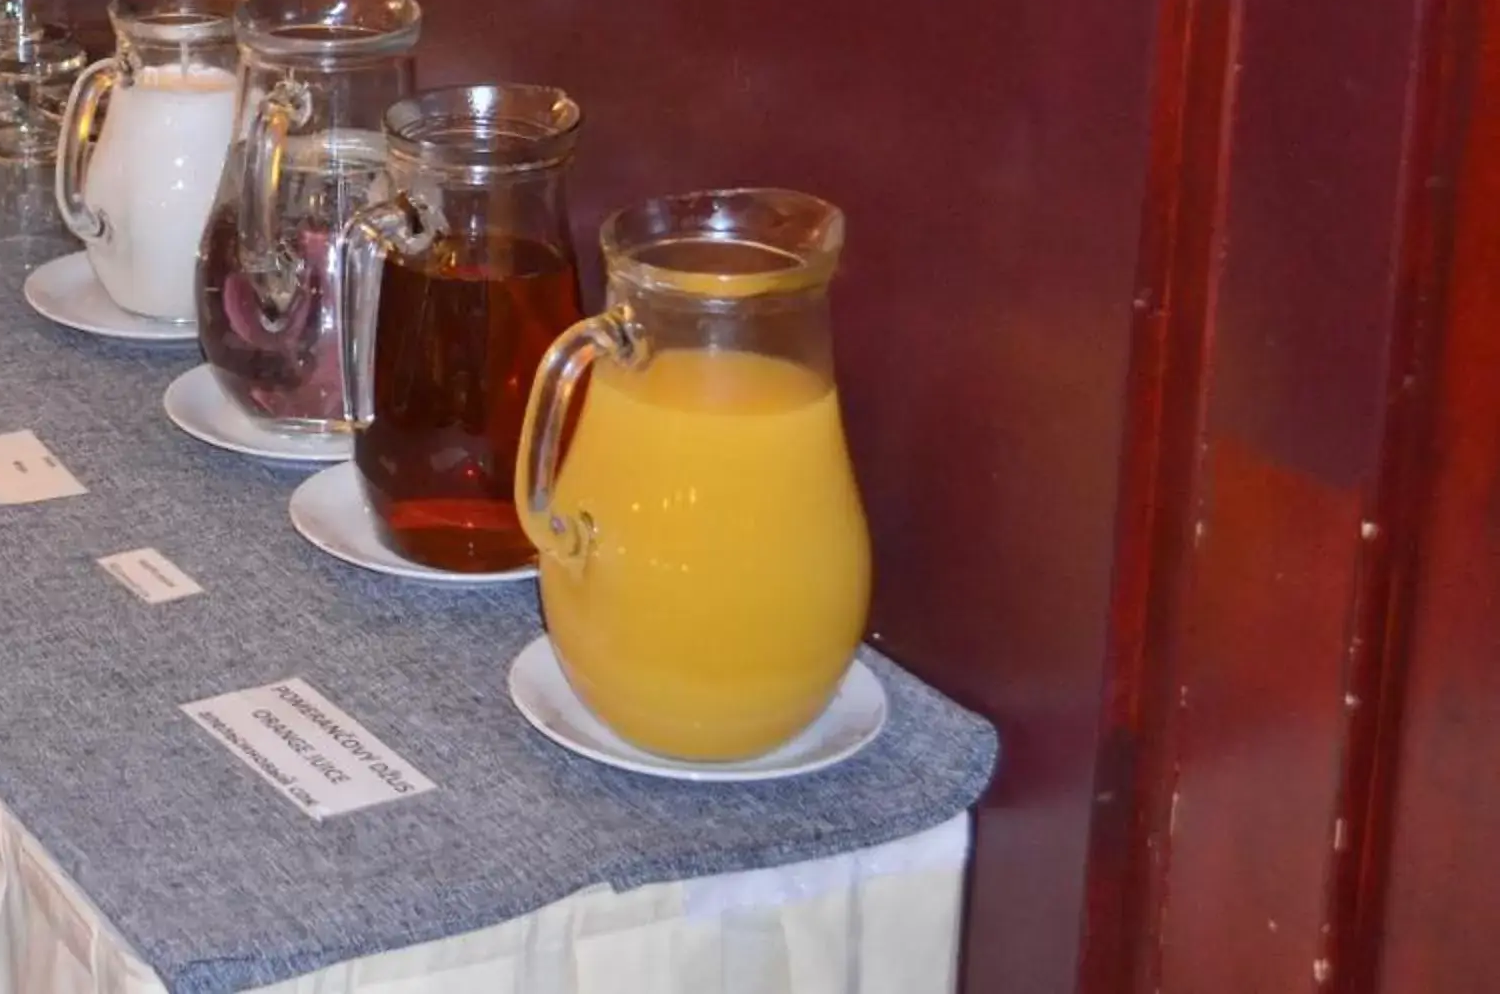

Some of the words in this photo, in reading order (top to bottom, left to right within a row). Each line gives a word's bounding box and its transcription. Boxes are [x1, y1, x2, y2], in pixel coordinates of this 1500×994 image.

[251, 708, 315, 759] ORANGE
[308, 753, 352, 785] JUICE
[271, 684, 376, 761] POMERANČOVÝ
[368, 760, 415, 794] DŽUS
